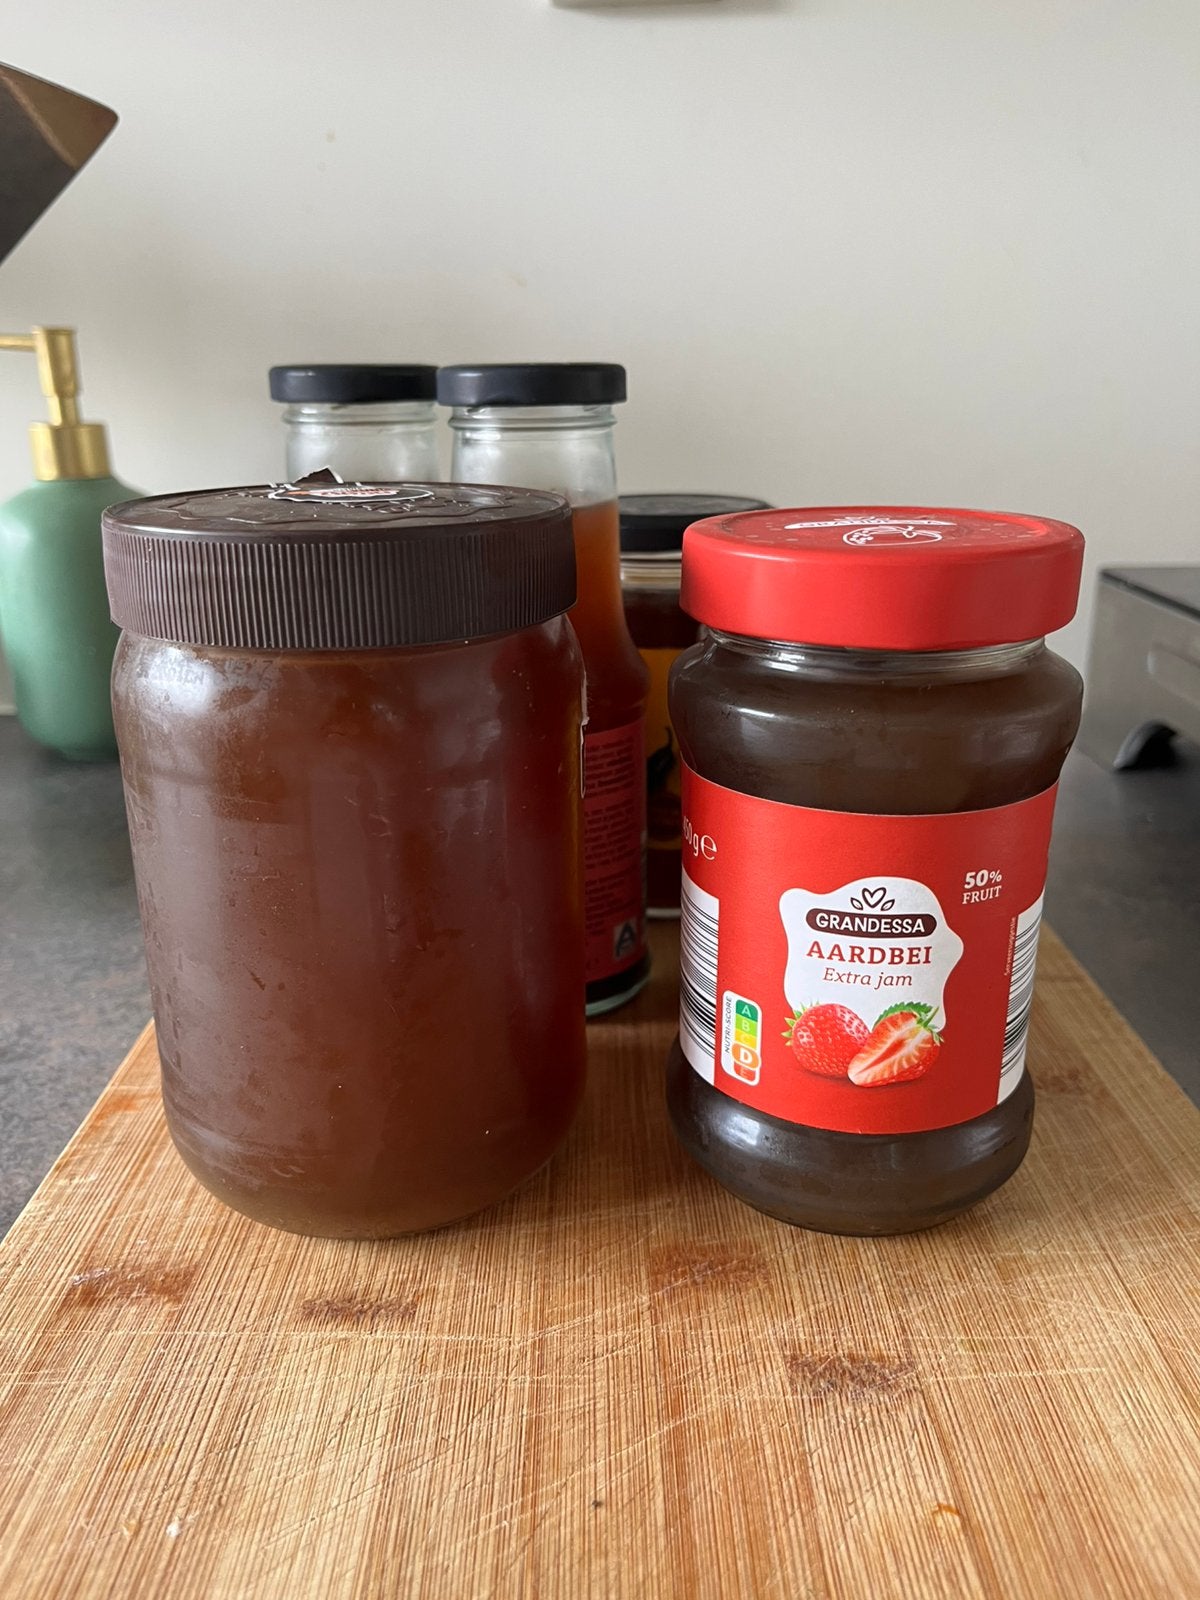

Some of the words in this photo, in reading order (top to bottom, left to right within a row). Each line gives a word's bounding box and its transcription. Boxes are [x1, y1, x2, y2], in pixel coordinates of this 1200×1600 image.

[964, 869, 1003, 889] 50%
[961, 886, 1001, 905] FRUIT
[815, 912, 926, 935] GRANDESSA
[806, 940, 932, 965] AARDBEI
[823, 967, 871, 987] Extra
[874, 971, 913, 991] jam
[742, 1005, 752, 1018] A
[742, 1020, 751, 1032] B
[740, 1047, 753, 1064] D
